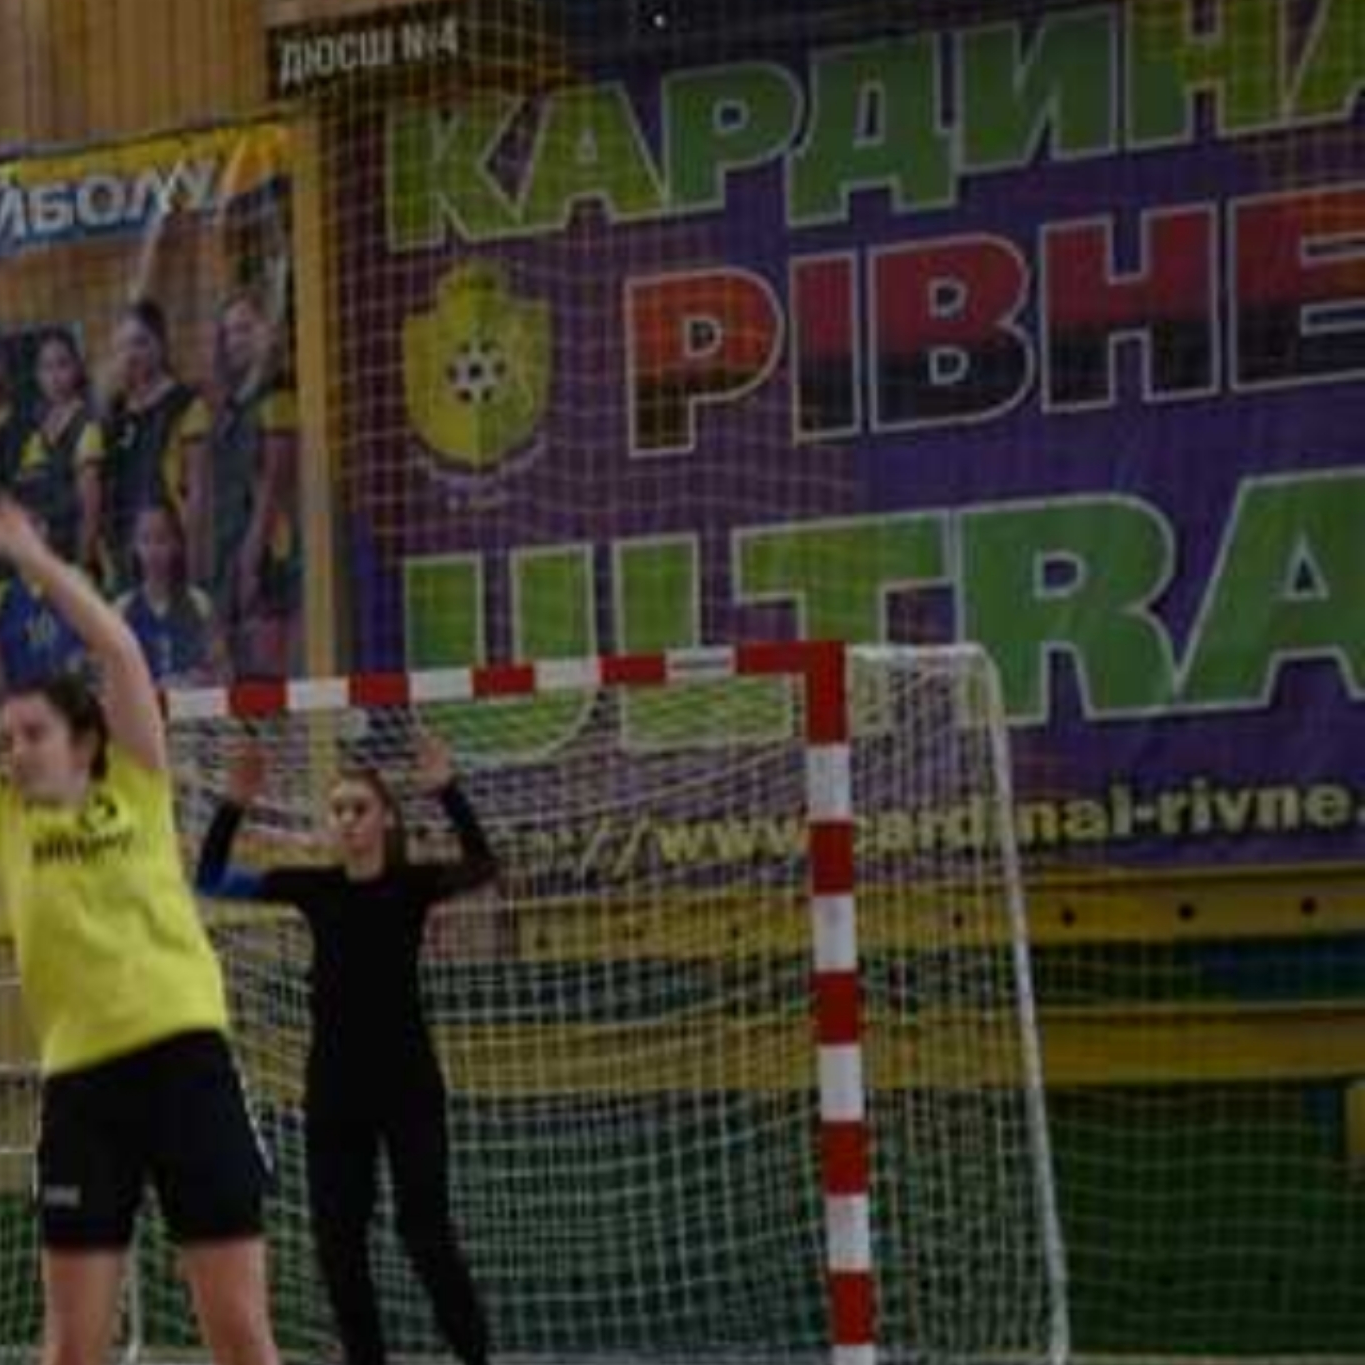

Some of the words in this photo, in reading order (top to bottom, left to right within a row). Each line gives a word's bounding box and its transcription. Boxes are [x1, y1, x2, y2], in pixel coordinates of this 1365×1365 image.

[279, 32, 395, 92] ДЮСШ
[623, 185, 1365, 460] РІВНЕ
[403, 462, 1365, 770] ULTRA
